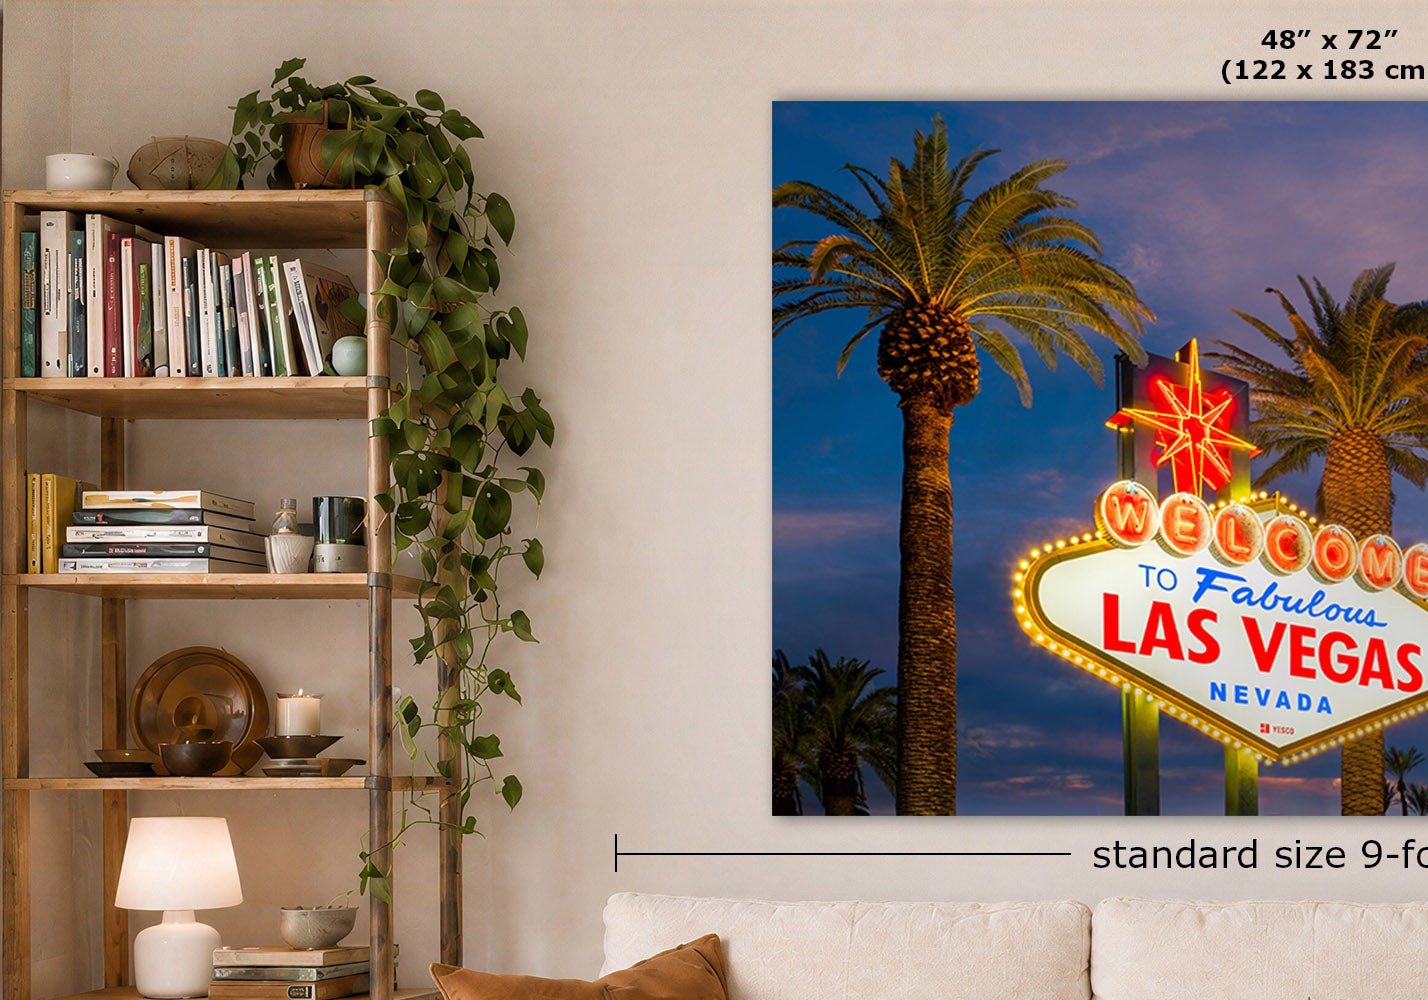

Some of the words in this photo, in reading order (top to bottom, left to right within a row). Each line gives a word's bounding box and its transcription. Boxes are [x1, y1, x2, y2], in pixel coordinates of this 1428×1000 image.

[1138, 563, 1178, 592] TO
[1192, 566, 1388, 629] Fabulous
[1102, 592, 1222, 665] LAS
[1240, 614, 1424, 693] VEGAS
[1209, 681, 1333, 715] NEVADA
